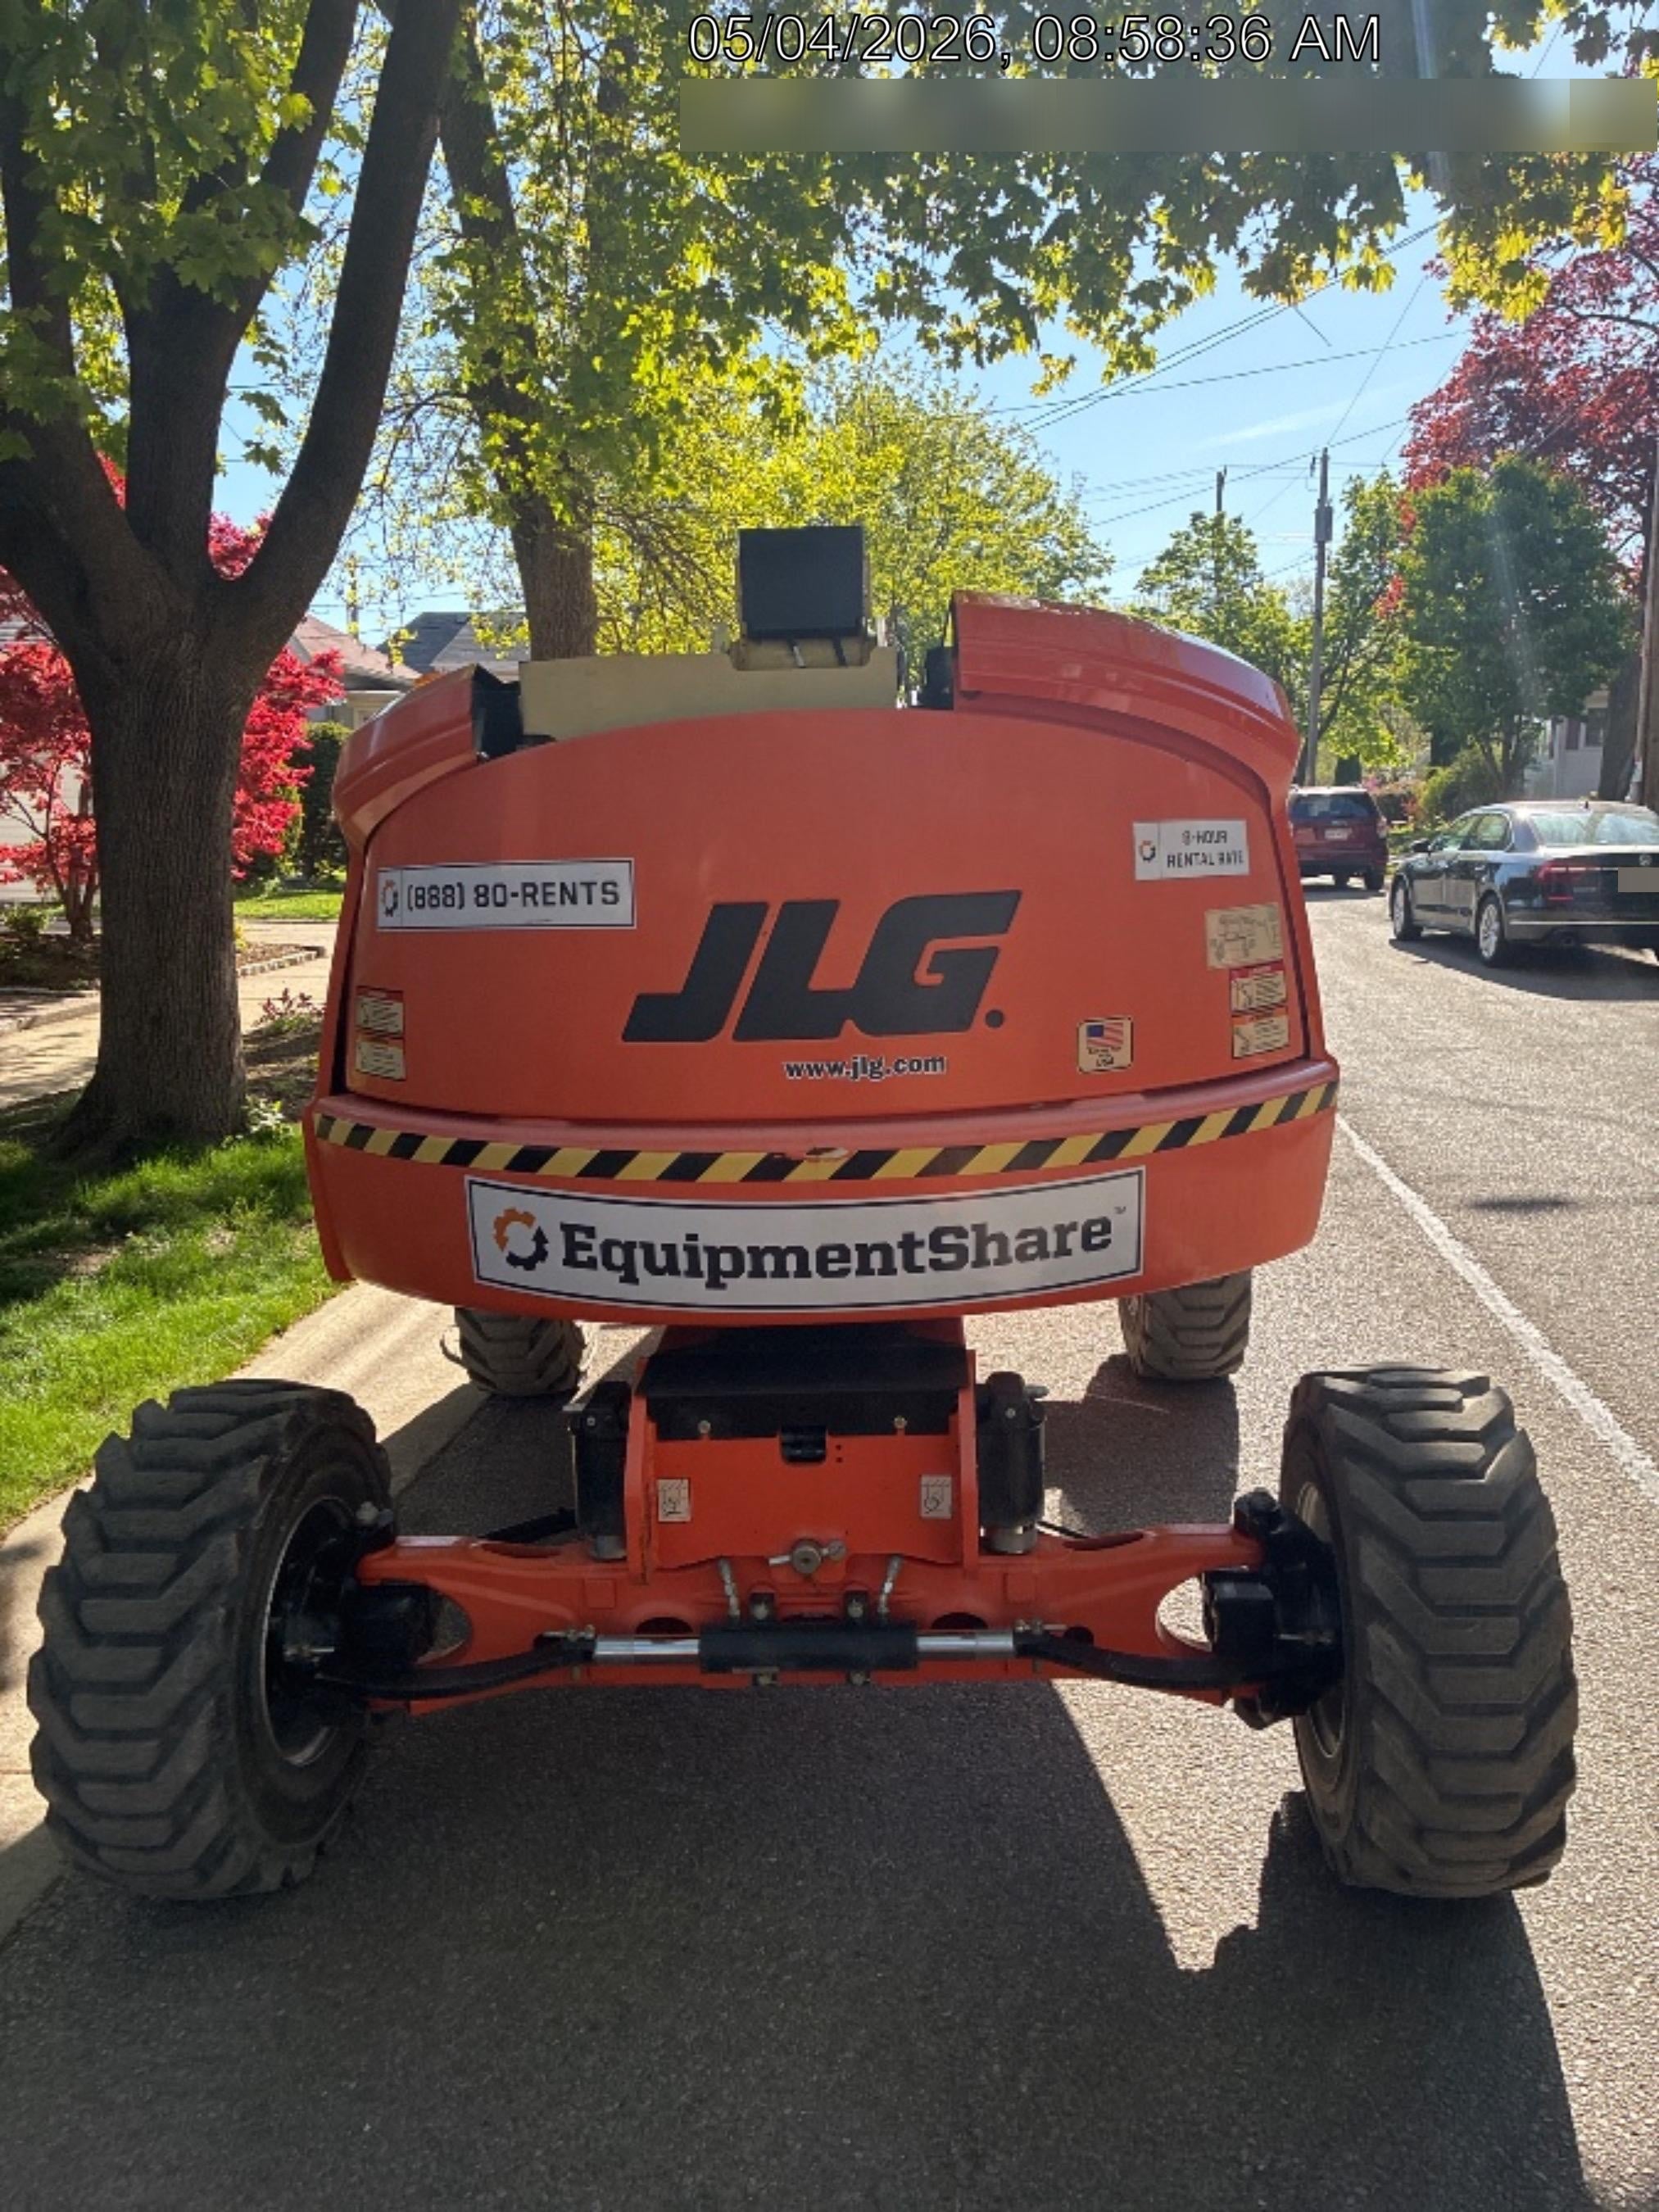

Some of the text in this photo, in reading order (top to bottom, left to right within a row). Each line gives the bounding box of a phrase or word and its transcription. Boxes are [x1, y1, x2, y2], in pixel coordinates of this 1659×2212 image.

[407, 882, 620, 911] (888) 80-RENTS
[622, 890, 1022, 1042] JLG
[784, 1055, 947, 1080] www.jlg.com
[560, 1214, 1113, 1290] EquipmentShare
